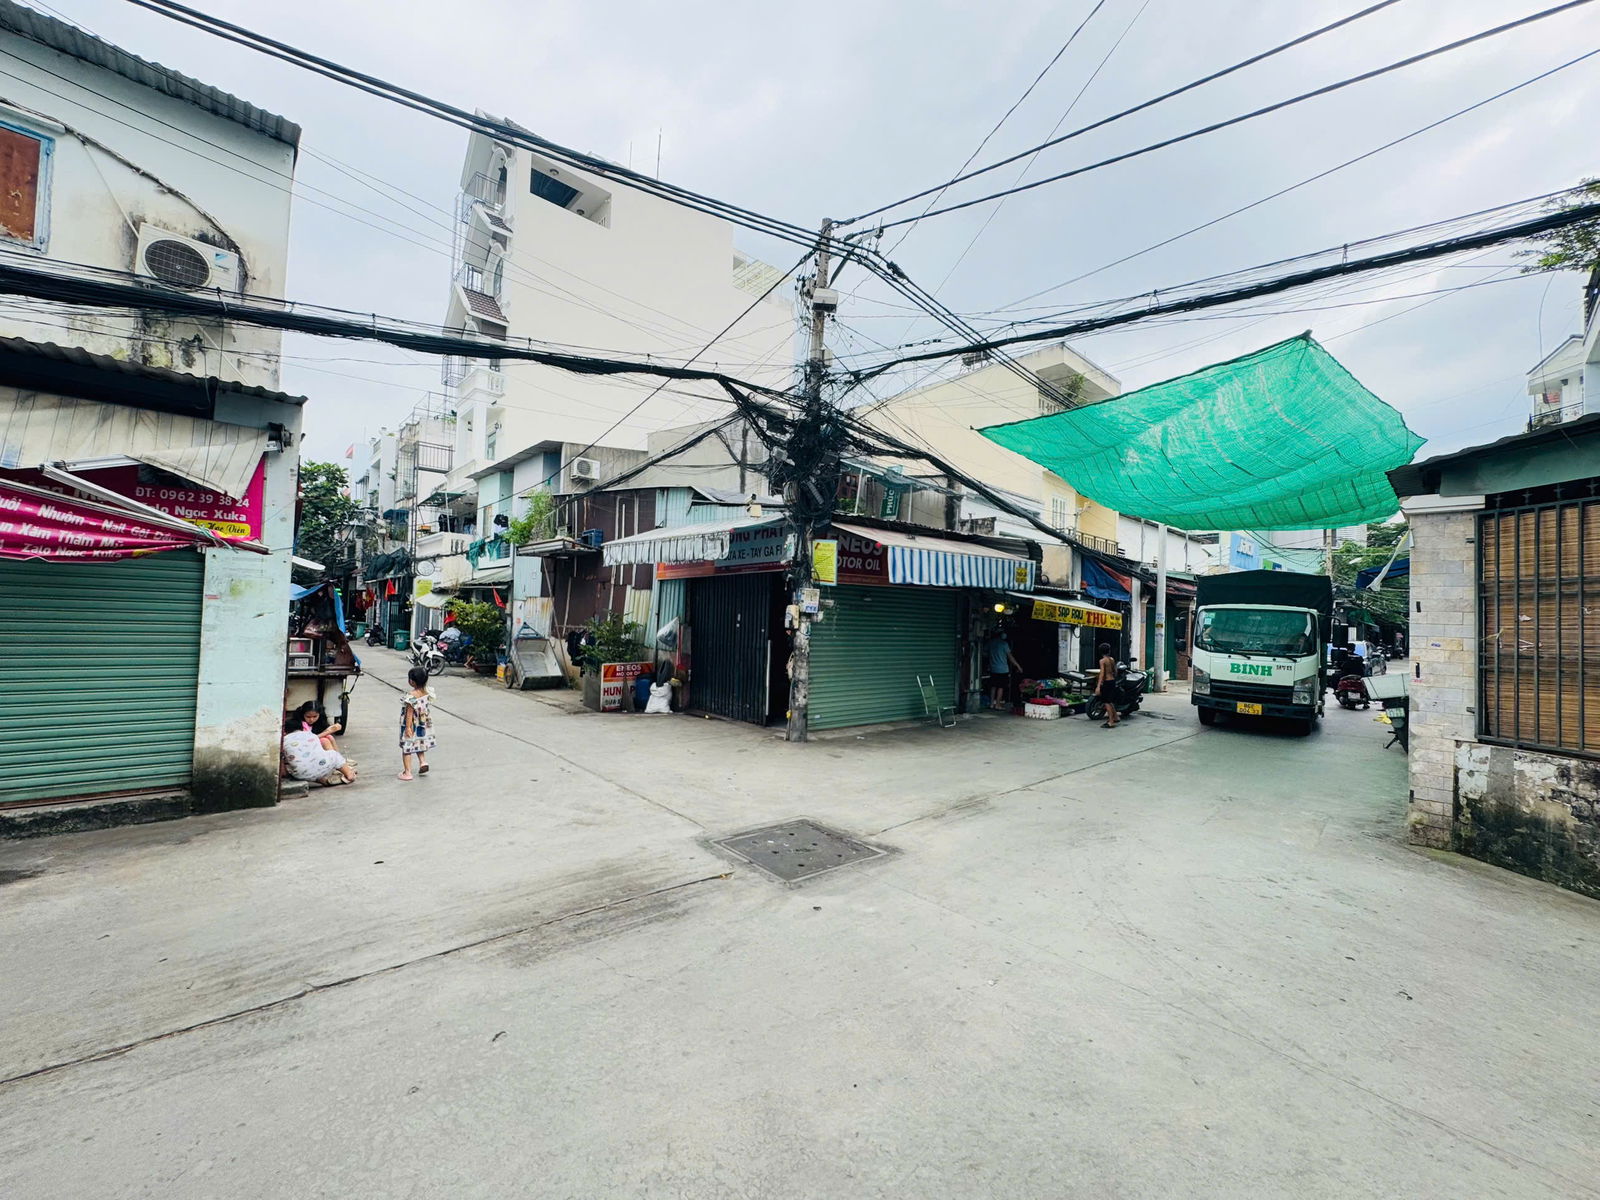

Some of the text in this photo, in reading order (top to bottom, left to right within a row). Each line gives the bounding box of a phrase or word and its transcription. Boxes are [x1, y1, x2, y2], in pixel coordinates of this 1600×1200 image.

[135, 487, 249, 508] ĐT: 0962 39 38 24
[214, 510, 247, 522] Xuka
[751, 545, 762, 559] TAY
[763, 544, 774, 557] GA
[837, 556, 881, 571] OTOR OIL
